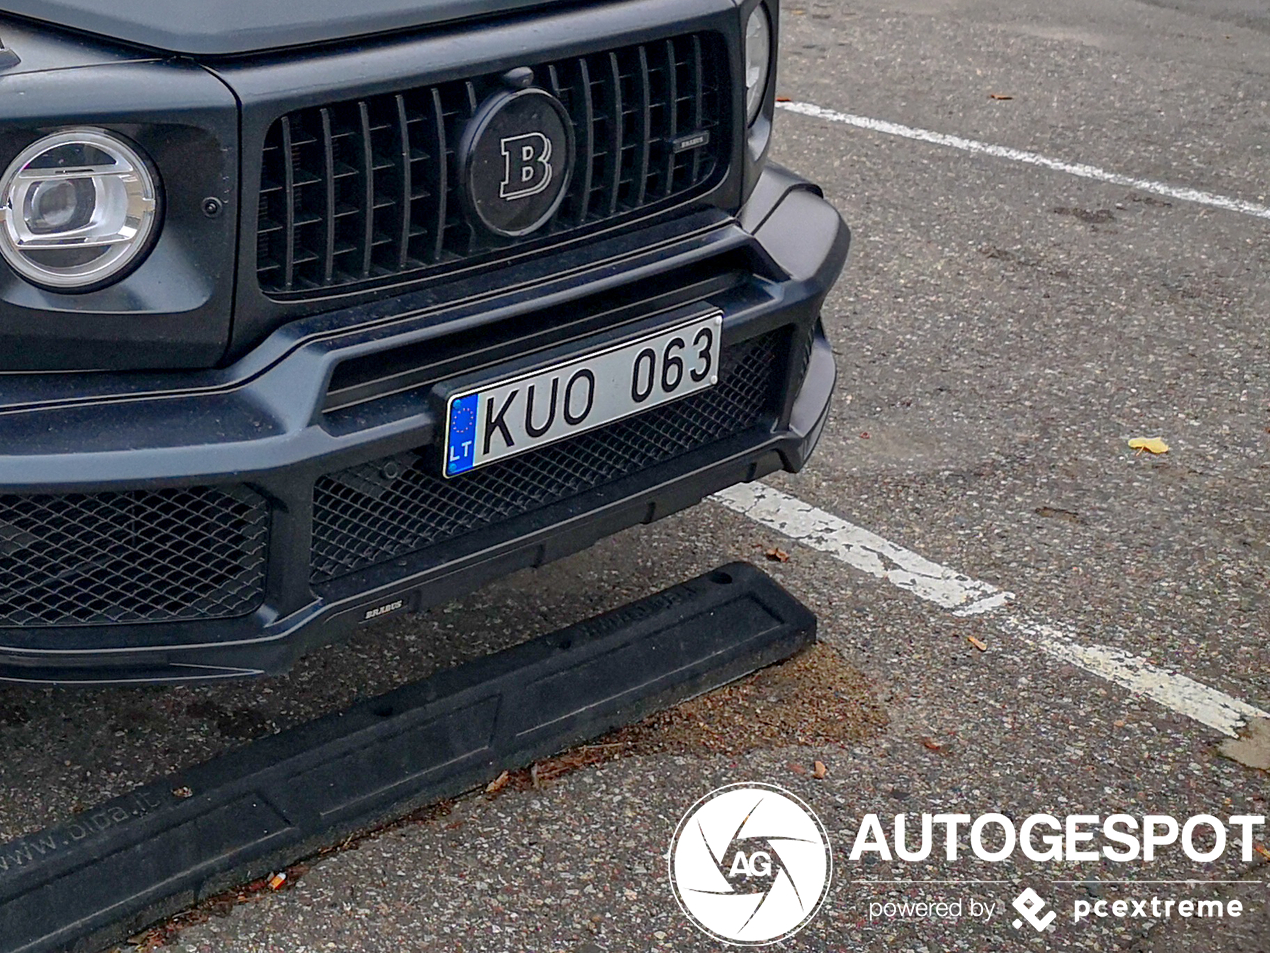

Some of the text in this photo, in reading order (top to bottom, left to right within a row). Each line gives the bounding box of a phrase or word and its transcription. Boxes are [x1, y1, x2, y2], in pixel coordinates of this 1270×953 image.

[499, 132, 553, 201] B
[482, 327, 714, 456] KUO 063
[448, 440, 473, 463] LT
